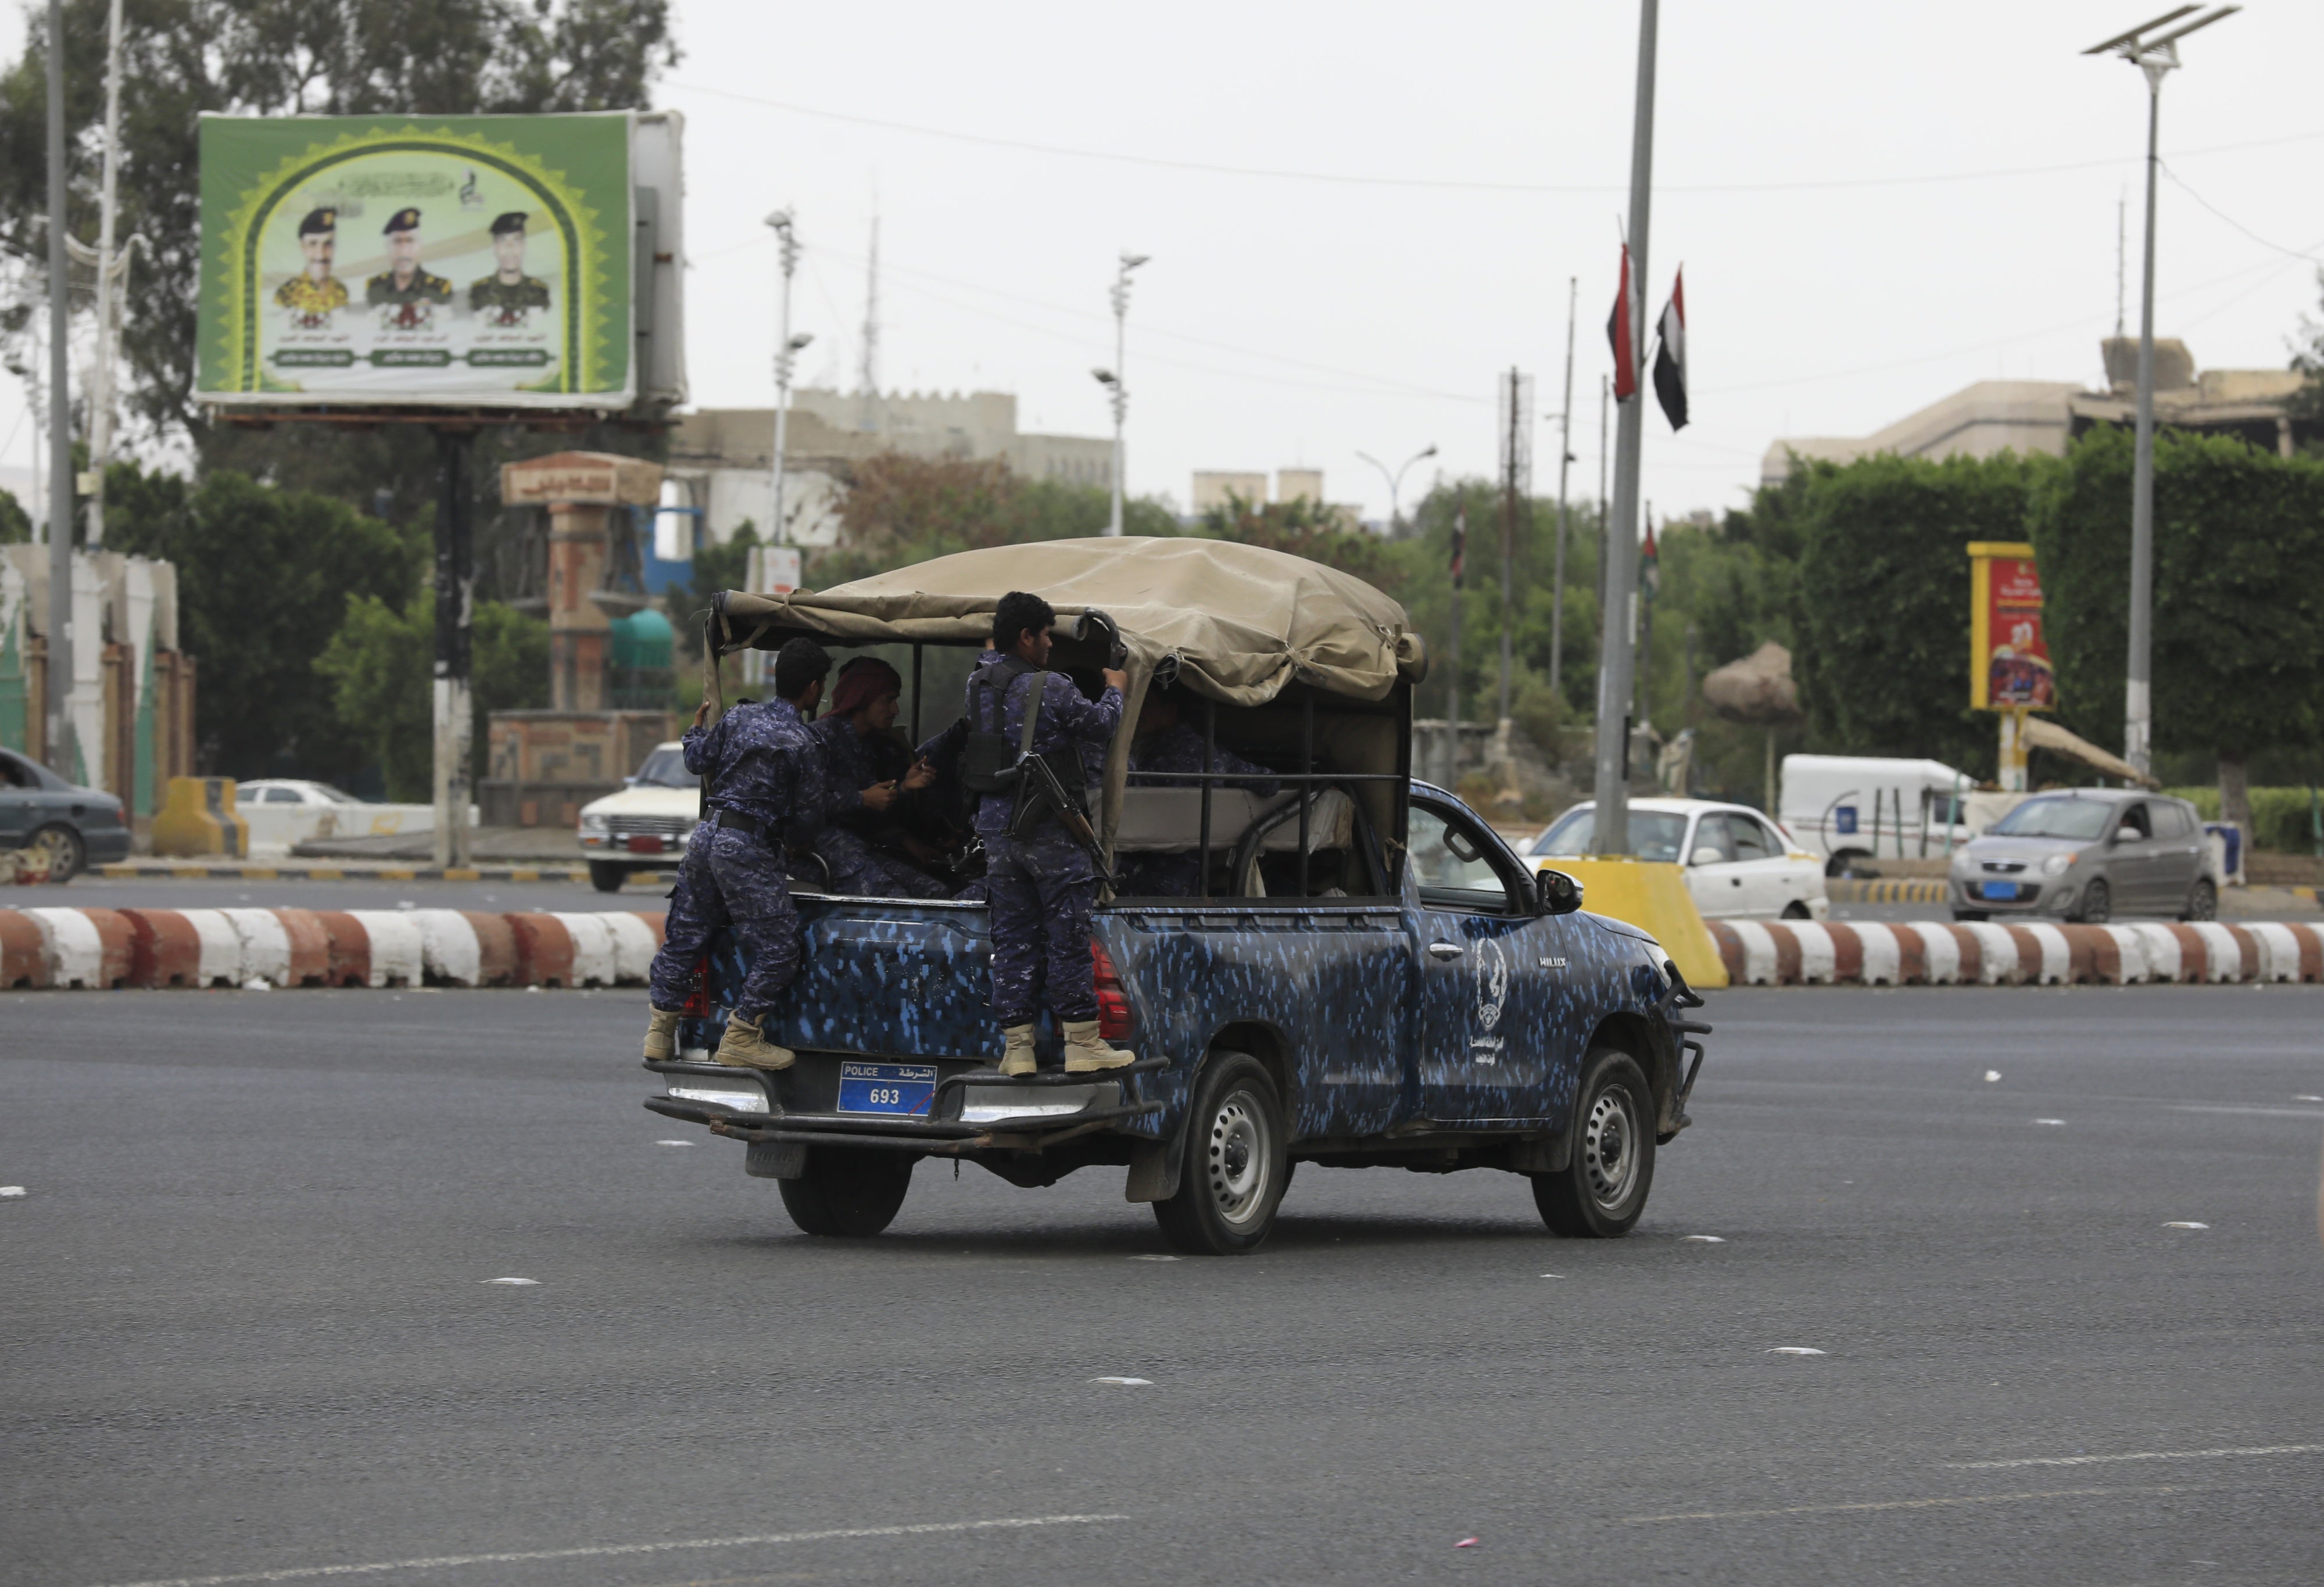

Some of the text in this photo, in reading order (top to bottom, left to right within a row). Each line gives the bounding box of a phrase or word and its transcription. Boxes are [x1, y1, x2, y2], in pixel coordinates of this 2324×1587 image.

[1539, 957, 1566, 967] HILUX
[844, 1066, 879, 1076] POLICE
[899, 1068, 933, 1079] الشرطة
[870, 1088, 899, 1105] 693
